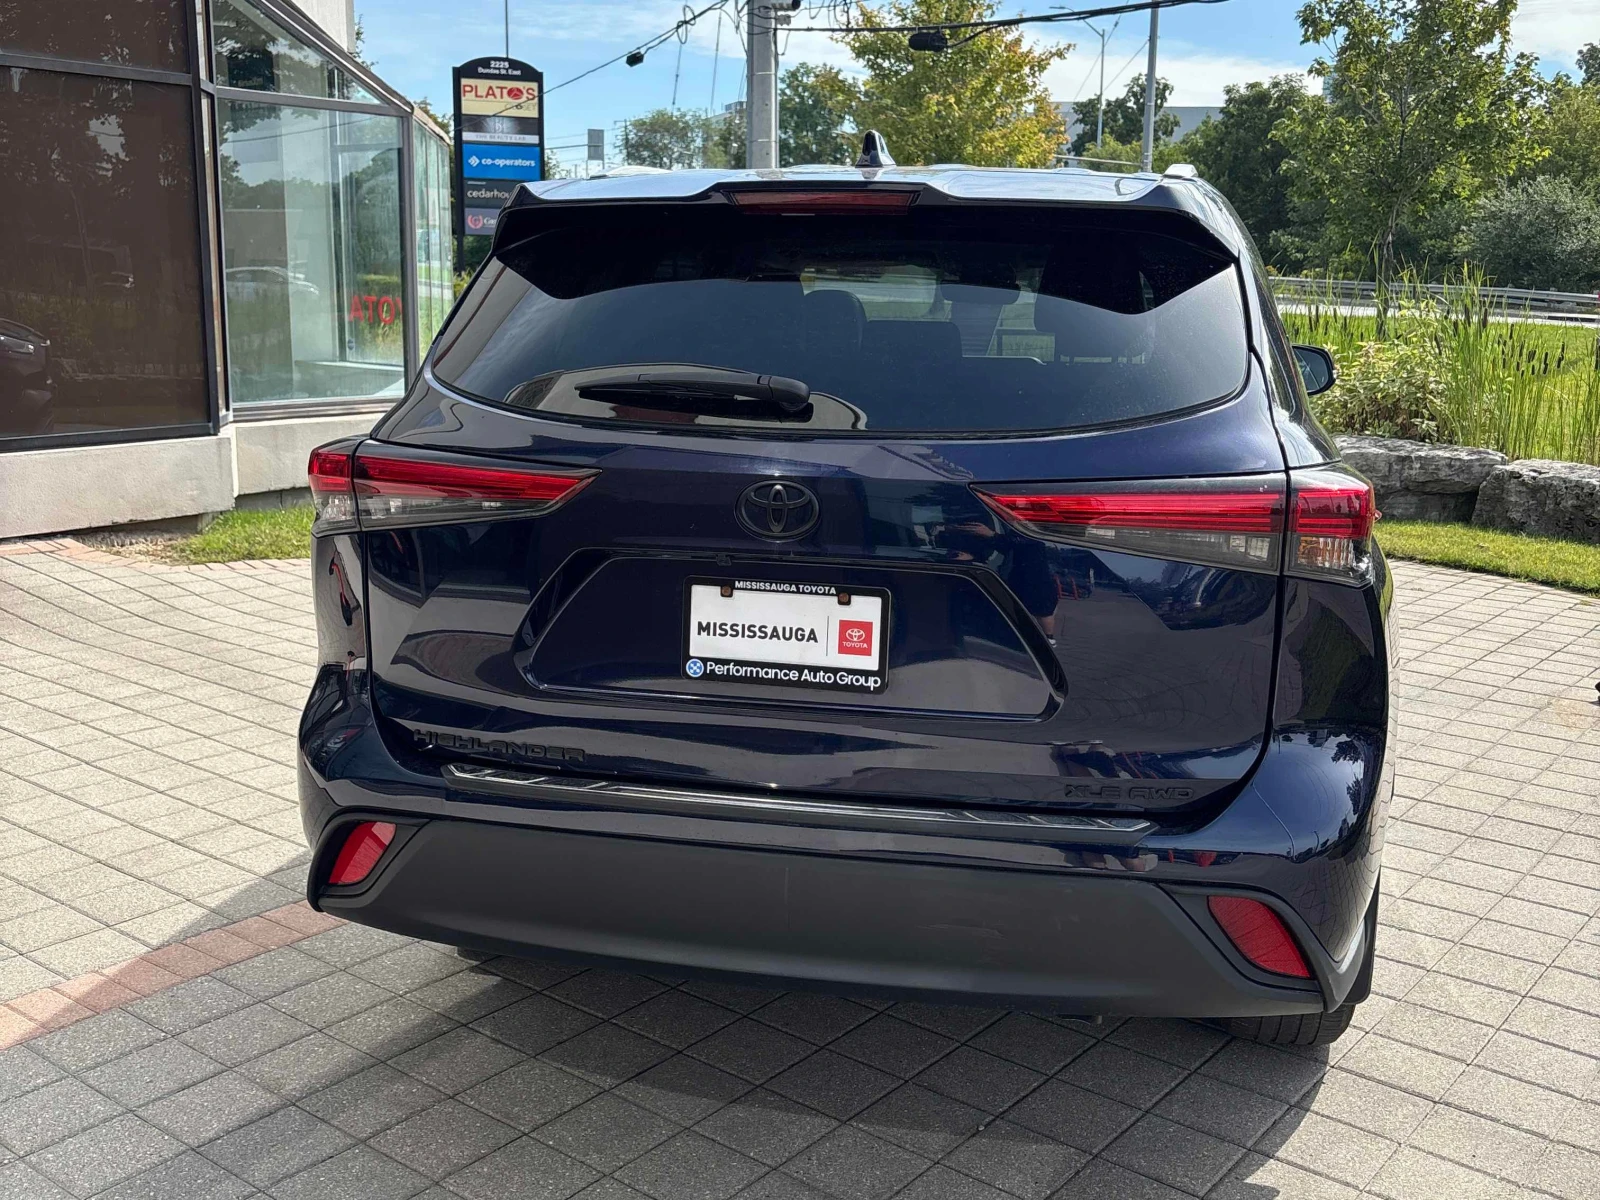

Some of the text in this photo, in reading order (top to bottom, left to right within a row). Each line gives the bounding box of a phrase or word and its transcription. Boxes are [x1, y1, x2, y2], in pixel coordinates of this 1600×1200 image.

[477, 66, 500, 74] Dundas
[490, 60, 509, 69] 2225
[462, 84, 536, 101] PLATO'S
[481, 157, 536, 168] co-operators
[734, 580, 837, 595] MISSISSAUGA TOYOTA
[697, 620, 818, 643] MISSISSAUGA
[842, 641, 868, 649] TOYOTA
[706, 661, 882, 691] Performance Auto Group
[413, 728, 586, 762] HIGHLANDER
[1064, 784, 1194, 800] XLE AWD
